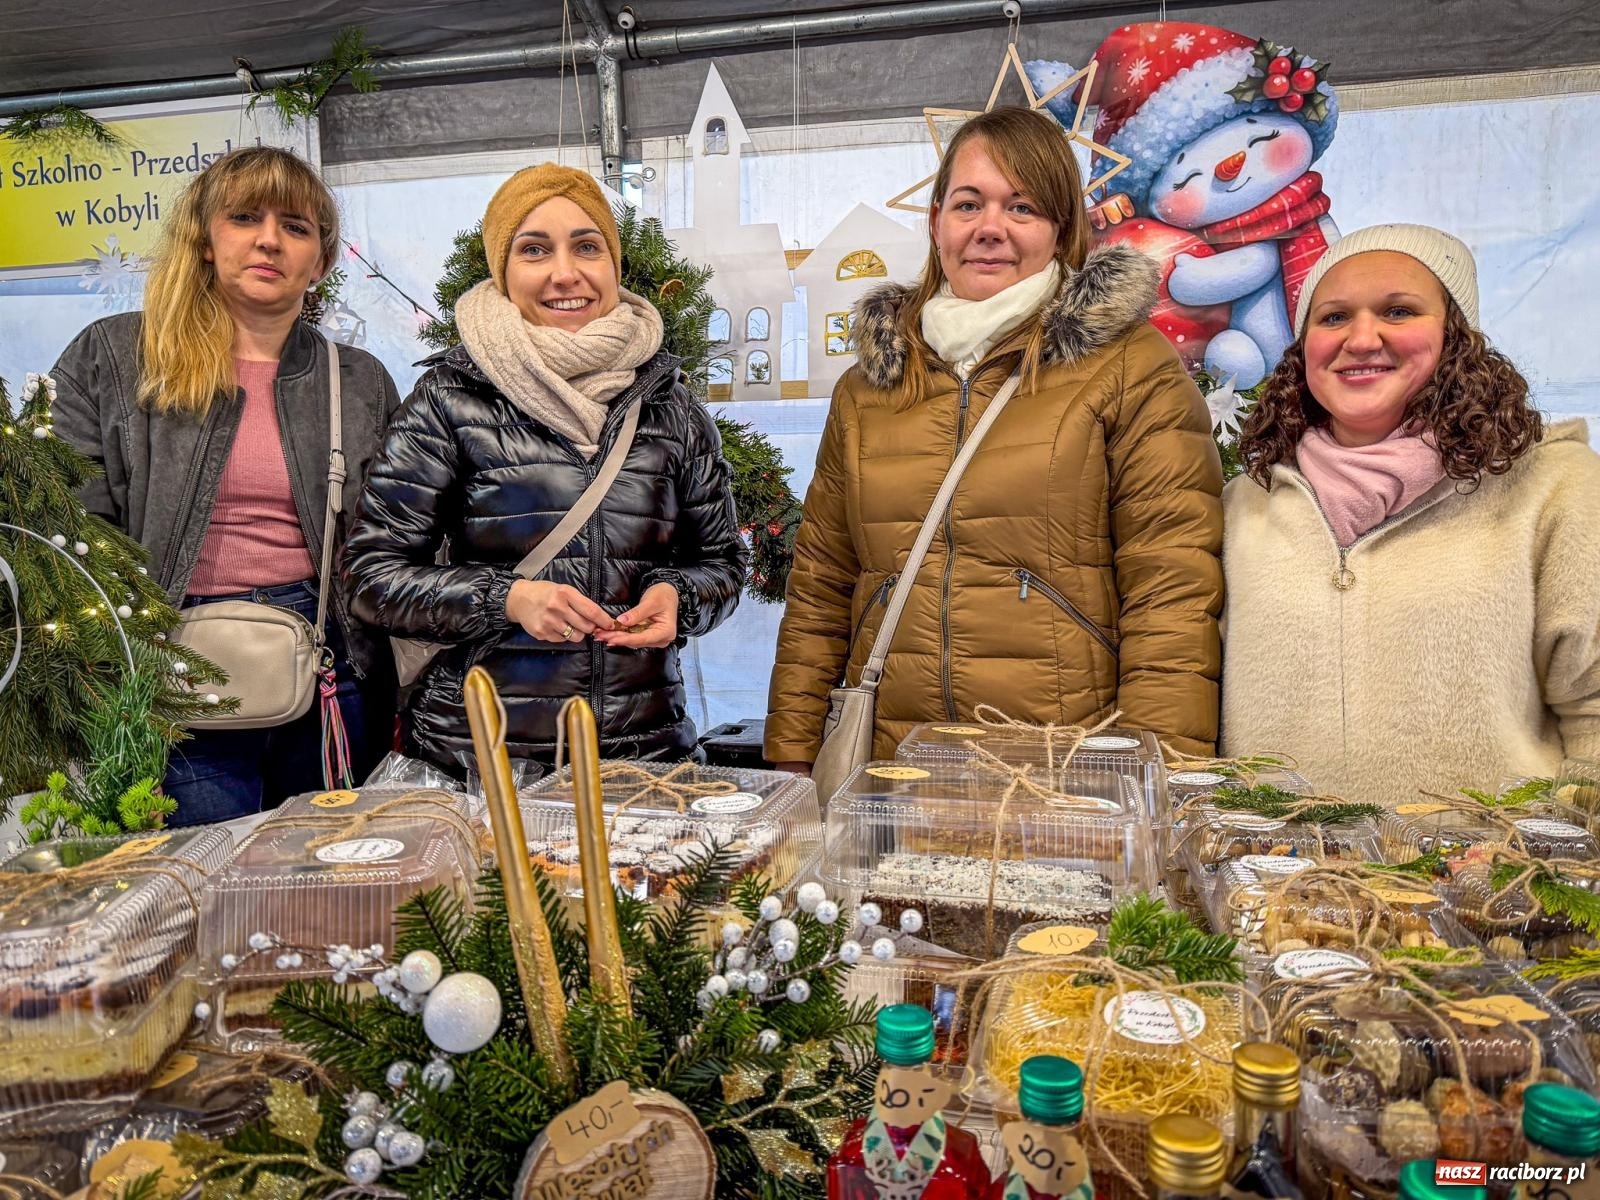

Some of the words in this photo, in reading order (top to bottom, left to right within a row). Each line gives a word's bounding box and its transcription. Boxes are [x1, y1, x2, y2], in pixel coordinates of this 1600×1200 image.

[12, 153, 103, 188] Szkolno
[55, 208, 76, 228] w
[84, 191, 160, 232] Kobyli
[565, 1100, 624, 1138] 40,-
